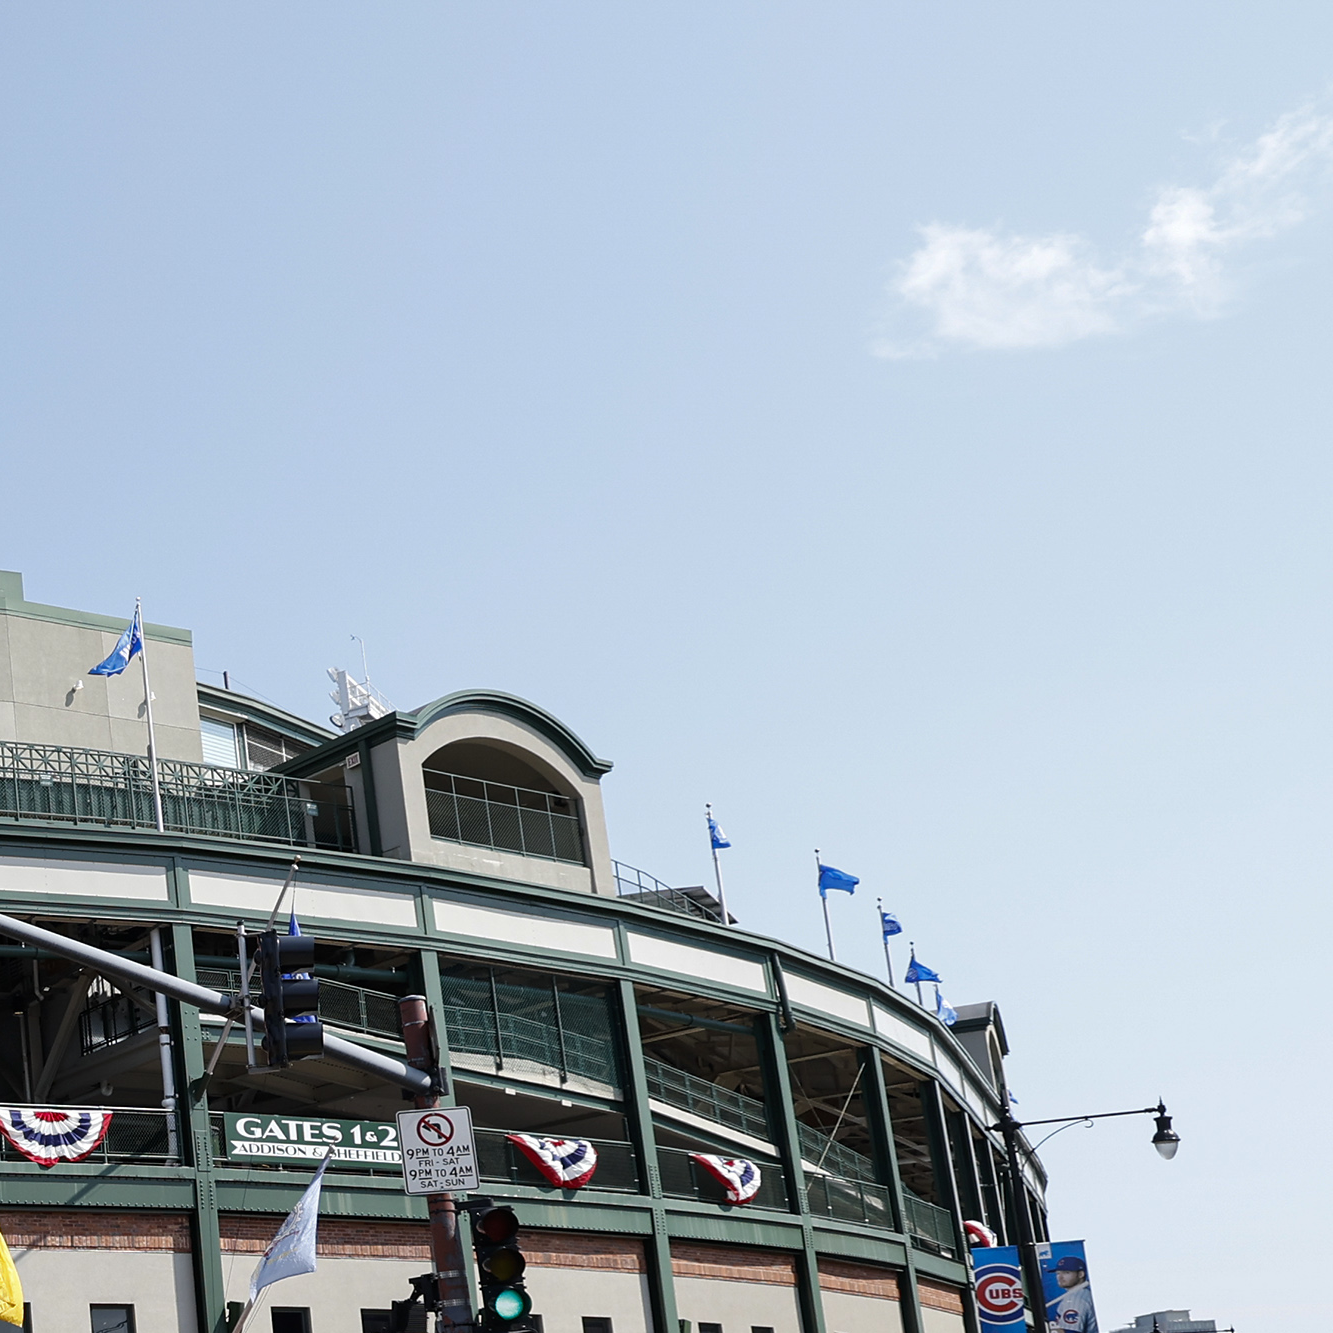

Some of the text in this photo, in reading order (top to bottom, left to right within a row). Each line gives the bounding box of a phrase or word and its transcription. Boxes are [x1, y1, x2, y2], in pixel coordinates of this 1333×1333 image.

[235, 1117, 343, 1144] GATES
[238, 1143, 402, 1163] ADDISON & SHEFFIELD
[432, 1148, 444, 1157] TO
[442, 1158, 460, 1166] SAT
[435, 1169, 447, 1177] TO
[420, 1179, 438, 1189] SAT
[445, 1178, 465, 1187] SUN
